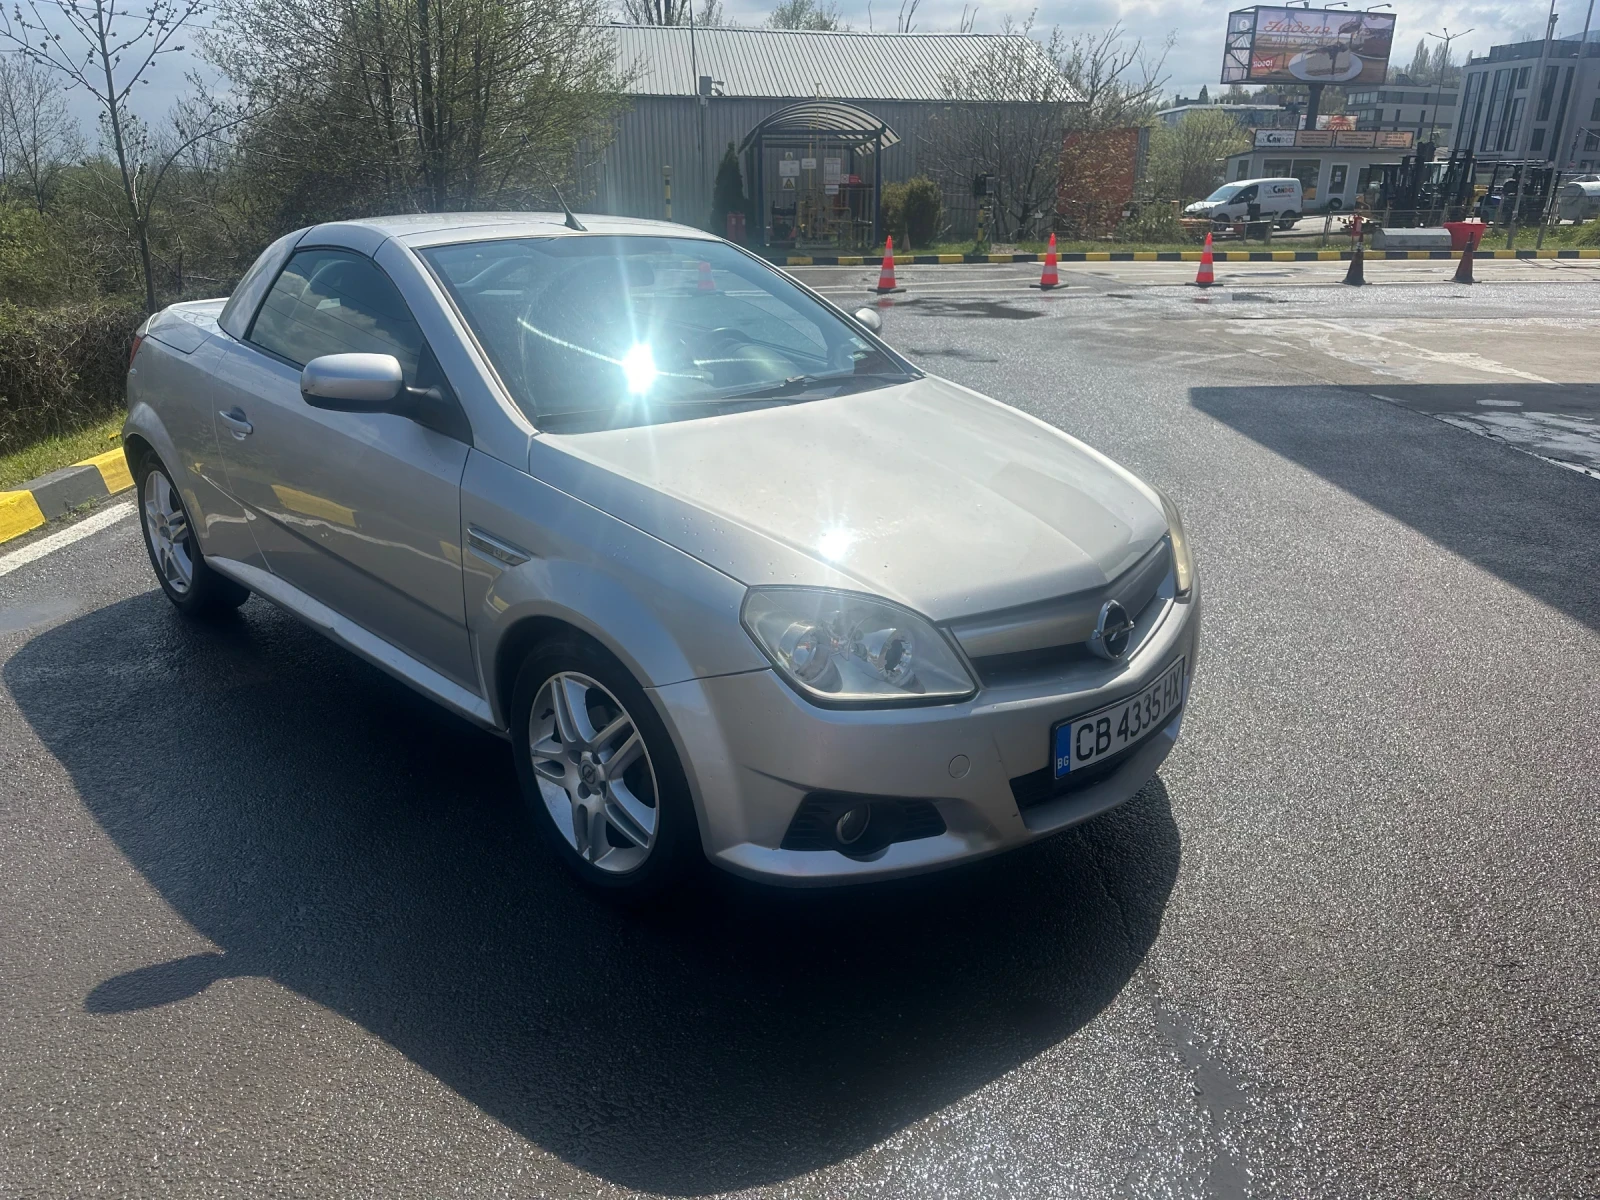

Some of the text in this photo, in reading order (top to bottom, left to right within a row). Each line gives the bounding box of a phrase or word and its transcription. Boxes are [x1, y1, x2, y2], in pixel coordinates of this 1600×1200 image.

[1264, 21, 1331, 34] Неделя
[1076, 667, 1181, 761] CB 4335 HX
[1057, 756, 1069, 769] BG
